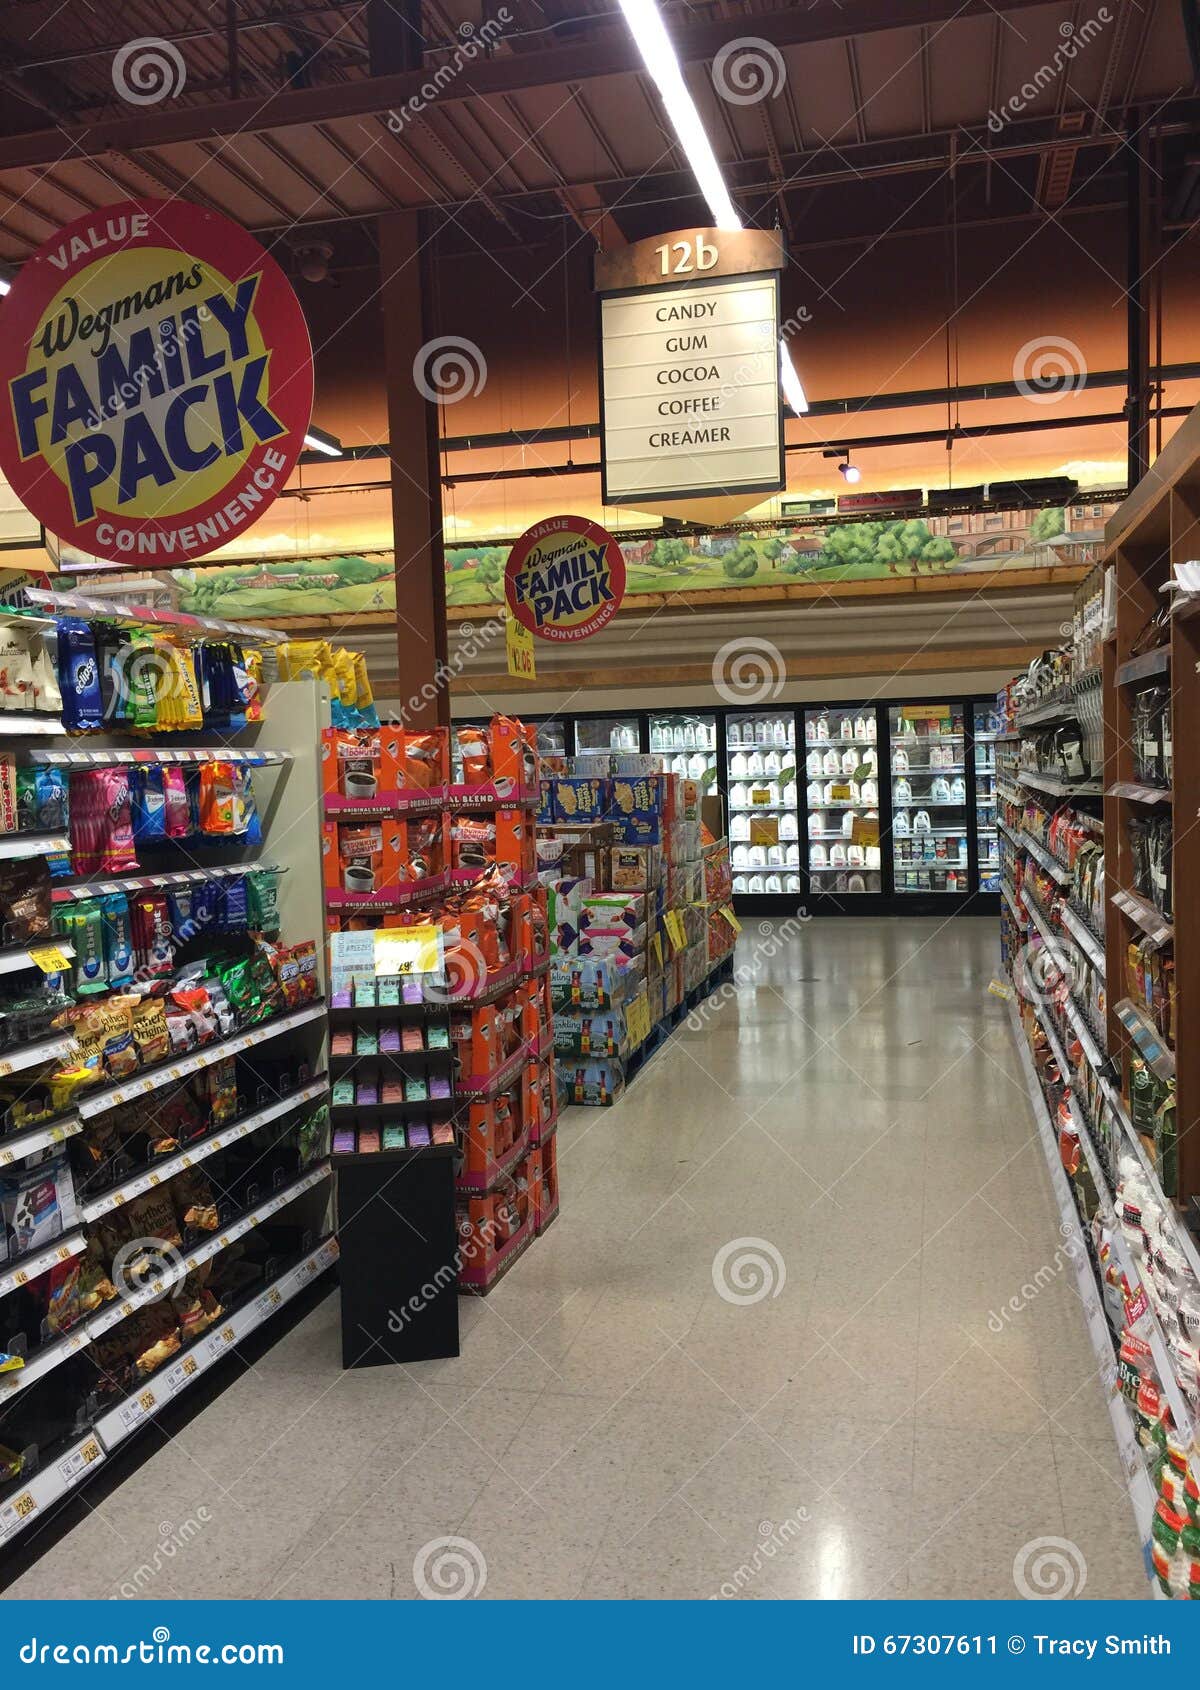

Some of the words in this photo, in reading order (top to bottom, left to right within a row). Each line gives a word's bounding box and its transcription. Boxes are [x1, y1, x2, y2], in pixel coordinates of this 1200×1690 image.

[47, 213, 150, 272] VALUE
[655, 234, 719, 276] 12b
[33, 263, 204, 359] Wegmans
[656, 301, 718, 322] CANDY
[665, 334, 708, 352] GUM
[11, 275, 259, 458] FAMILY
[656, 365, 720, 384] COCOA
[657, 397, 720, 416] COFFEE
[63, 354, 286, 524] PACK
[648, 426, 731, 448] CREAMER
[96, 447, 287, 554] CONVENIENCE
[529, 519, 569, 539] VALUE
[525, 539, 589, 570] Wegmans
[0, 572, 28, 596] gmans
[514, 543, 608, 603] FAMILY
[533, 571, 615, 627] PACK
[543, 602, 615, 640] CONVENIENCE
[75, 657, 96, 695] eclipse
[1, 760, 15, 832] WHOPPERS
[462, 794, 494, 803] BLEND
[551, 972, 571, 982] kling
[1119, 1360, 1142, 1389] Bre
